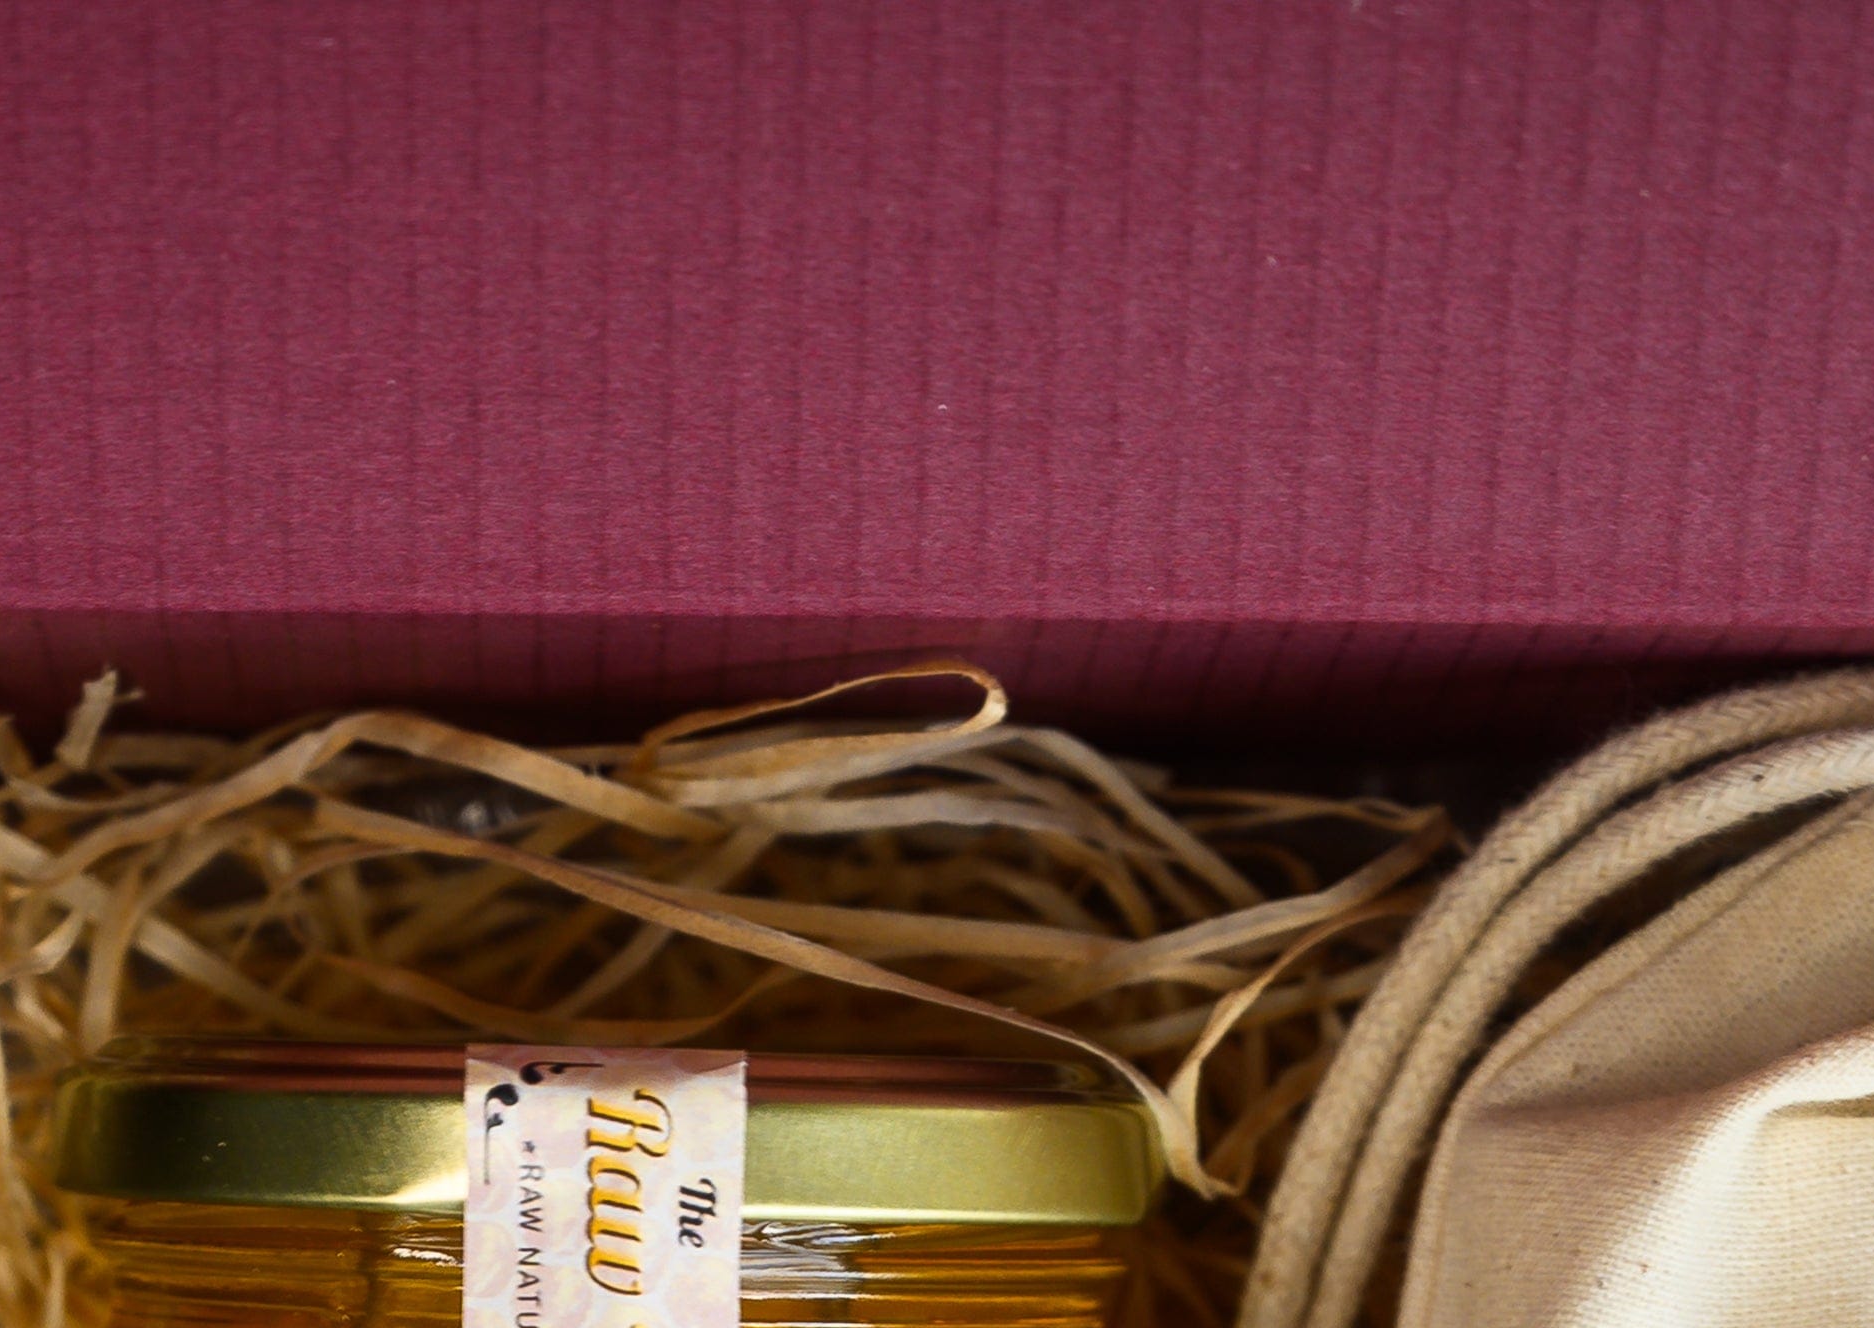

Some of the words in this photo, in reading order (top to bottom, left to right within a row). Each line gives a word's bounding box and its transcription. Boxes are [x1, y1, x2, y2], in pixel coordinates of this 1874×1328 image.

[518, 1161, 544, 1238] RAW
[583, 1086, 676, 1297] Raw
[677, 1176, 719, 1249] The
